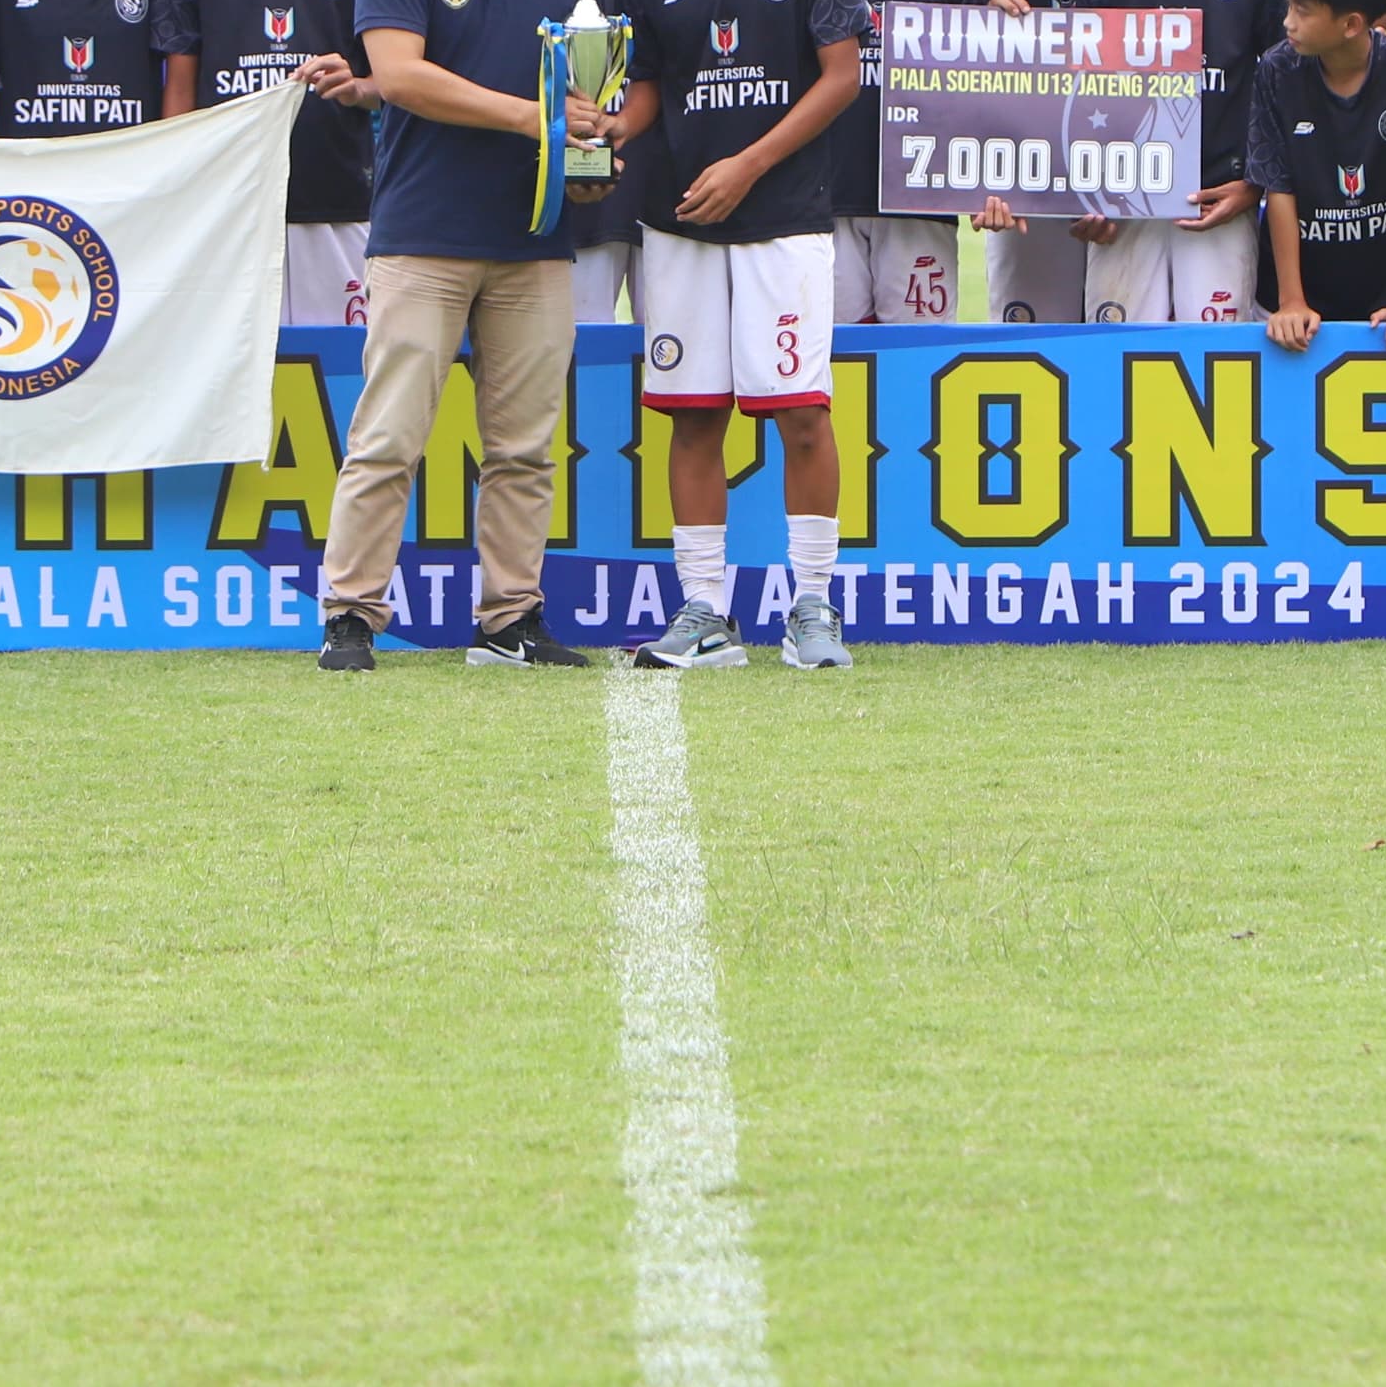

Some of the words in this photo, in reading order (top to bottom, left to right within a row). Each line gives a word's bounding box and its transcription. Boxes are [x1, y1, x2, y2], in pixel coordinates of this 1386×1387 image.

[892, 6, 1103, 66] RUNNER
[1123, 13, 1192, 67] UP
[37, 84, 122, 97] UNIVERSITAS
[216, 67, 286, 95] SAFIN
[739, 80, 789, 106] PATI
[890, 67, 942, 92] PIALA
[946, 69, 1033, 95] SOERATIN
[1037, 72, 1073, 96] U13
[1077, 73, 1143, 97] JATENG
[1148, 75, 1196, 98] 2024
[14, 98, 86, 124] SAFIN
[94, 99, 143, 124] PATI
[887, 106, 919, 123] IDR
[902, 135, 1175, 194] 7.000.000
[1299, 220, 1362, 242] SAFIN
[72, 228, 115, 322] SCHOOL
[904, 266, 948, 317] 45
[777, 330, 802, 379] 3
[575, 564, 797, 627] JAA
[835, 562, 1135, 625] TENGAH
[1169, 561, 1366, 624] 2024
